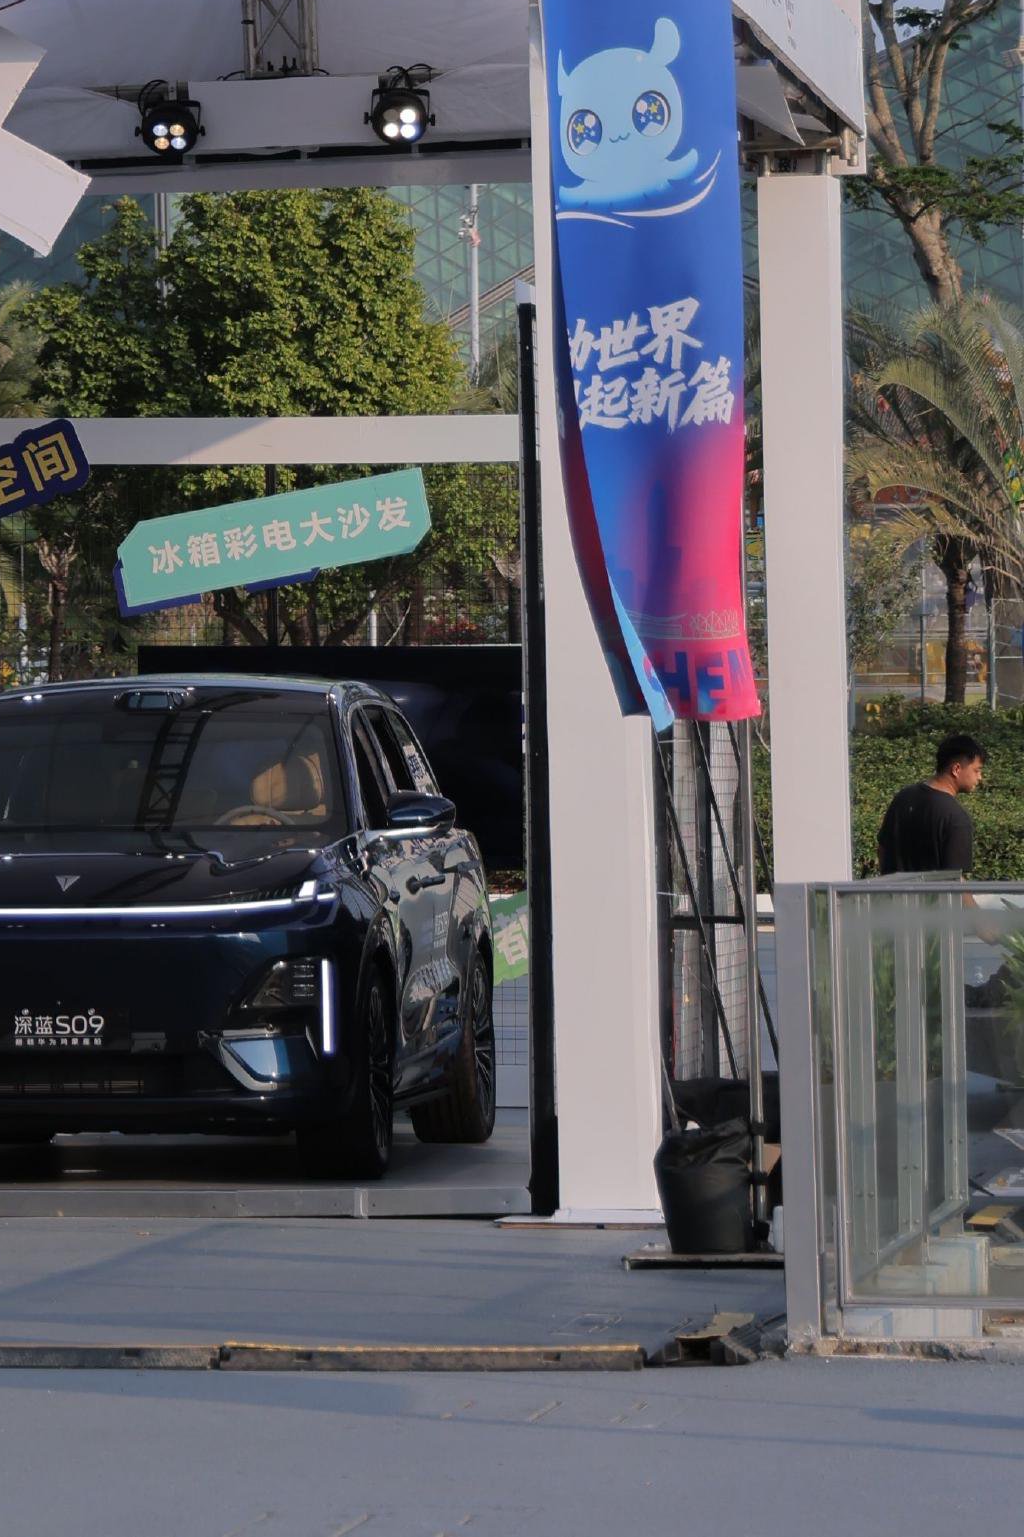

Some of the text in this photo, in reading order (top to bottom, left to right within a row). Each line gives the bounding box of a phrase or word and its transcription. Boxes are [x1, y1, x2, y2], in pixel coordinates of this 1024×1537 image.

[147, 496, 411, 574] 冰箱彩电大沙发
[14, 1016, 104, 1034] 深蓝S09
